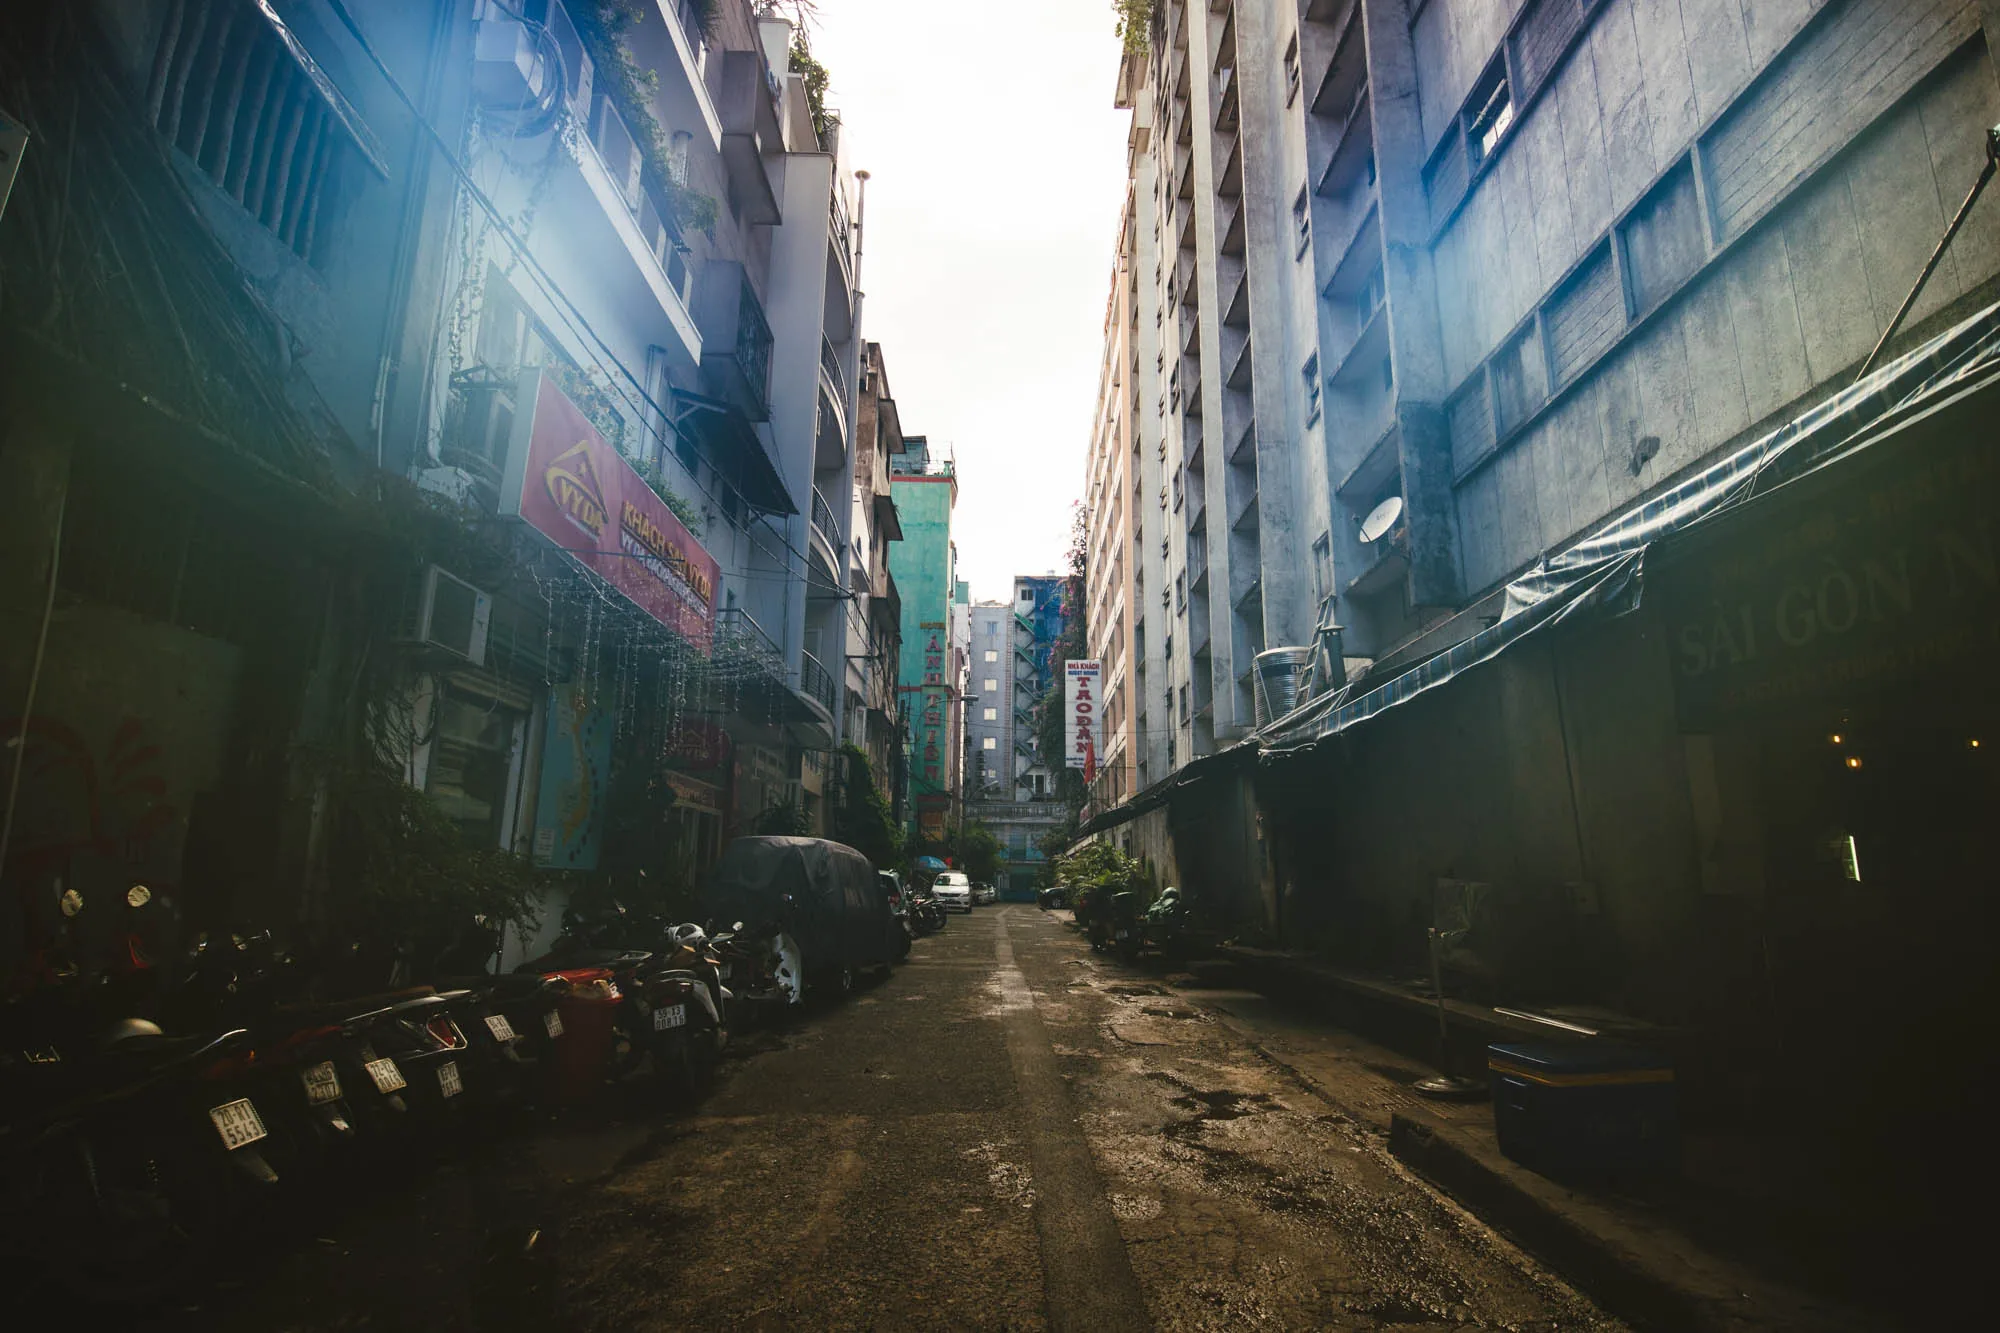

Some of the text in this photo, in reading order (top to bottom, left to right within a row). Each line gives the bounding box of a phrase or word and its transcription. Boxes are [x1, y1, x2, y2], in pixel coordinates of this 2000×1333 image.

[1678, 599, 1759, 678] SÀI
[1775, 553, 1914, 648] GÒN
[1080, 661, 1100, 670] KHÁCH
[226, 1120, 261, 1145] 5543
